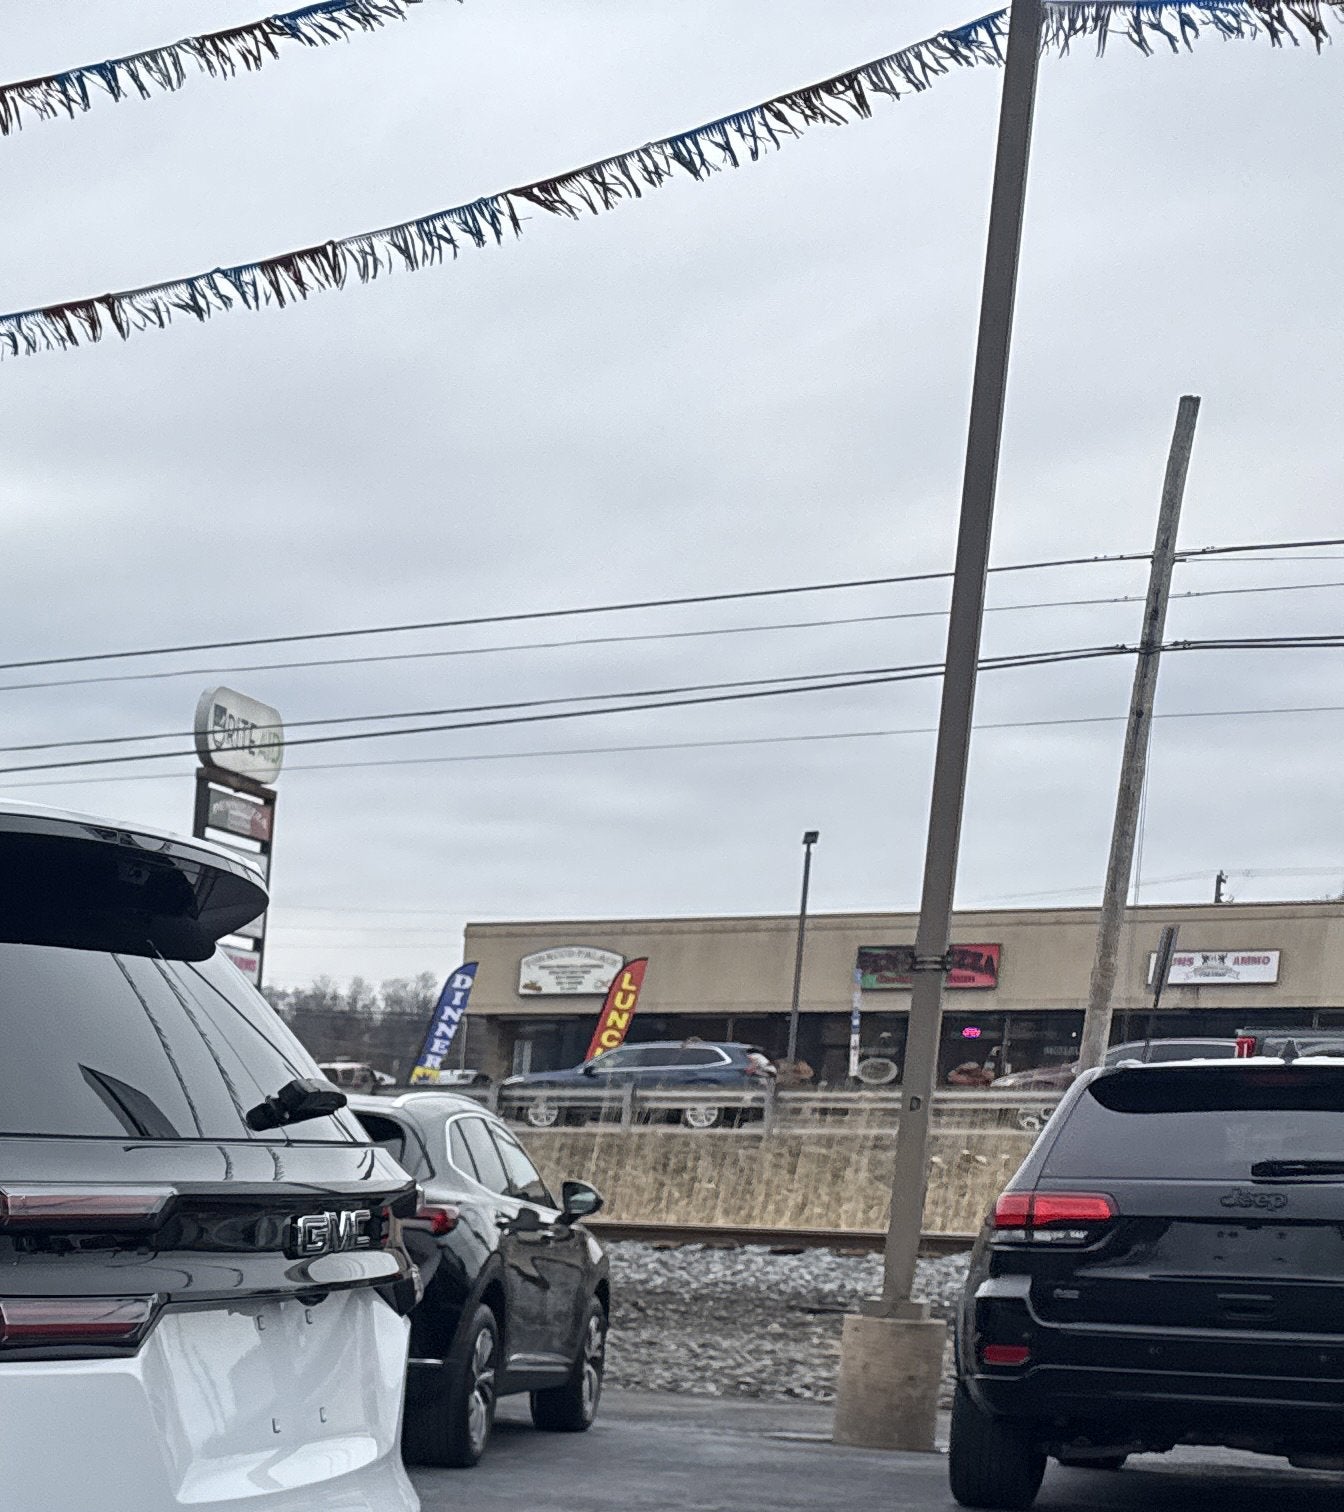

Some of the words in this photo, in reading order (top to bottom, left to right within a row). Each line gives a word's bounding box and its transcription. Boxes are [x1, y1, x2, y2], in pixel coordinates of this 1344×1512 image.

[227, 713, 257, 757] RITE
[1232, 954, 1271, 967] AMMO
[424, 973, 472, 1068] DINNER
[1220, 1188, 1289, 1212] Jeep
[296, 1209, 371, 1257] GMC
